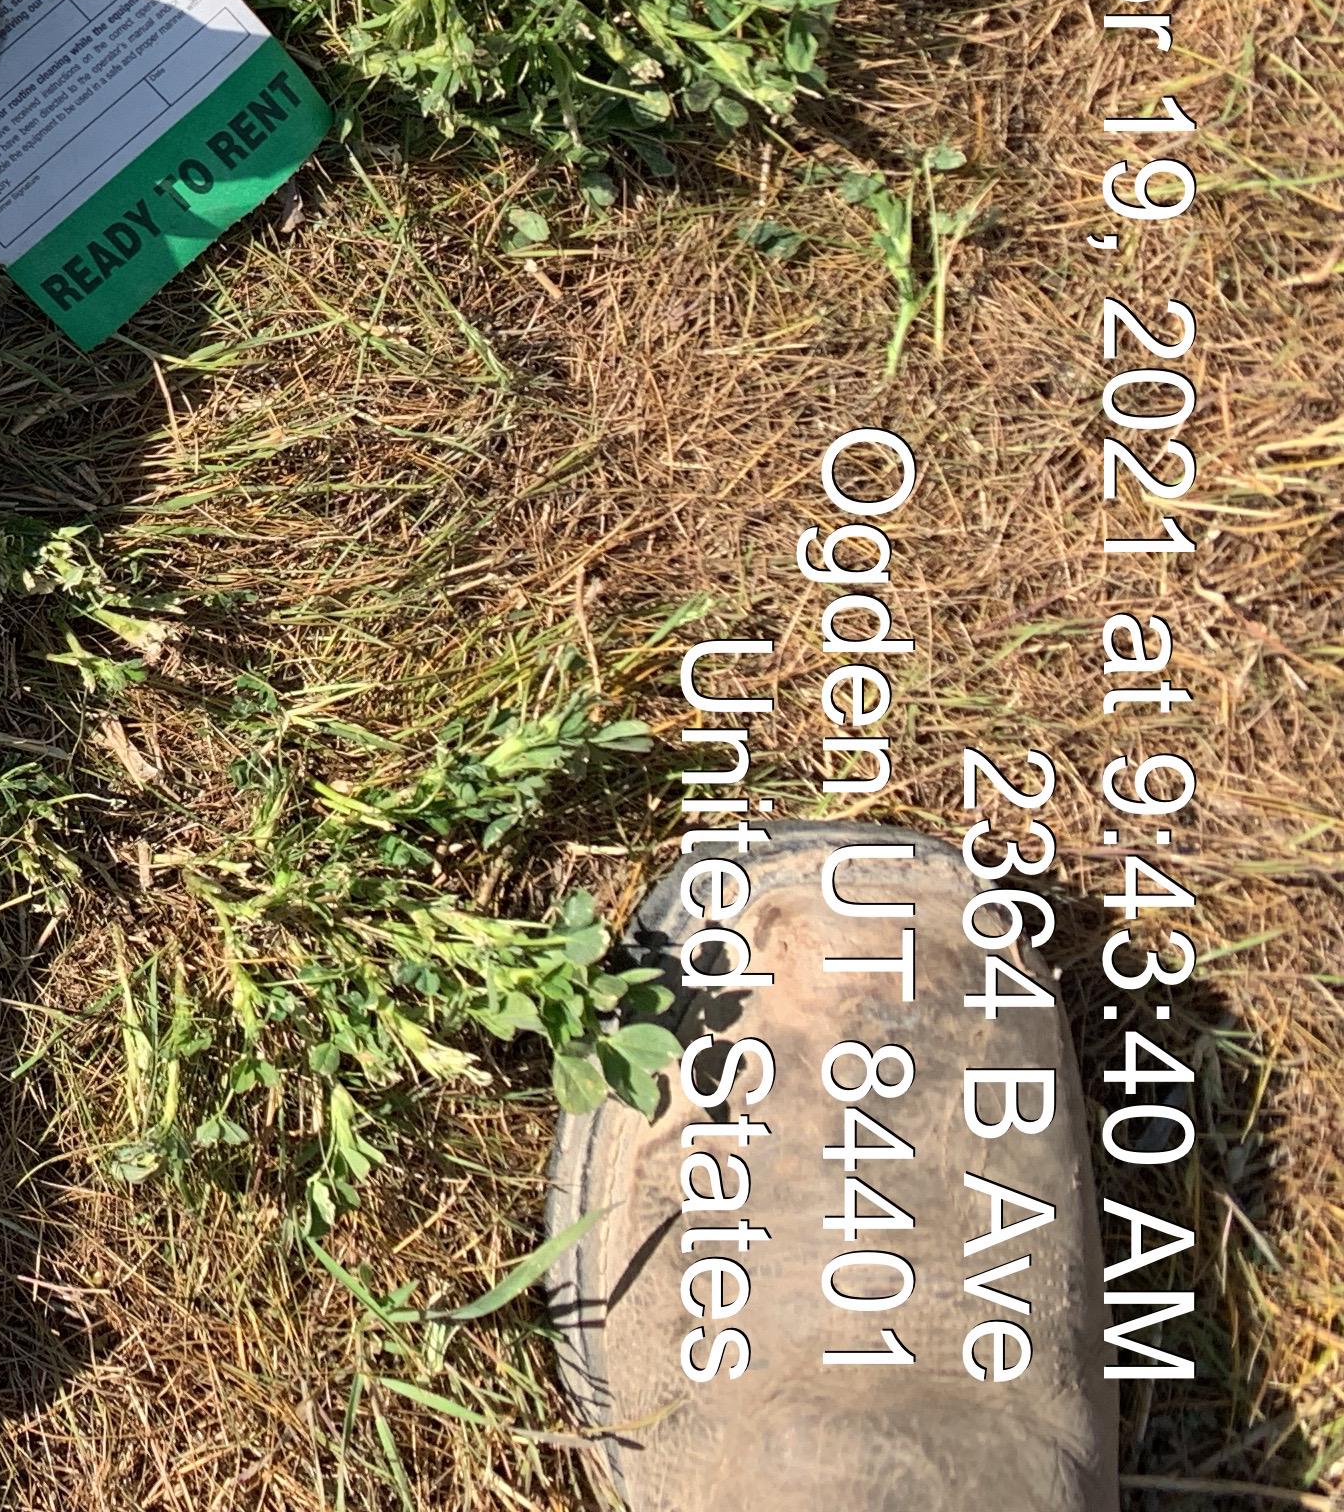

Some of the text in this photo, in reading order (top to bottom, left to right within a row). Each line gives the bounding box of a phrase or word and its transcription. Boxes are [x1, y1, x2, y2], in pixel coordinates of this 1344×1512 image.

[0, 133, 20, 151] have
[17, 117, 40, 135] been
[39, 90, 69, 118] directed
[66, 83, 78, 93] to
[76, 72, 92, 84] the
[127, 16, 155, 43] manual
[7, 83, 37, 109] routine
[36, 54, 71, 84] cleaning
[69, 34, 93, 55] while
[91, 22, 108, 36] the
[7, 149, 23, 162] the
[21, 117, 58, 151] equipment
[55, 111, 66, 121] to
[62, 103, 76, 115] be
[73, 86, 94, 106] used
[91, 81, 101, 91] in
[98, 76, 108, 85] a
[105, 64, 123, 80] safe
[120, 50, 137, 67] and
[134, 31, 159, 56] proper
[10, 96, 41, 125] received
[41, 63, 81, 98] instructions
[81, 52, 94, 64] on
[92, 40, 108, 53] the
[108, 16, 134, 41] correct
[41, 70, 303, 312] READY TO RENT
